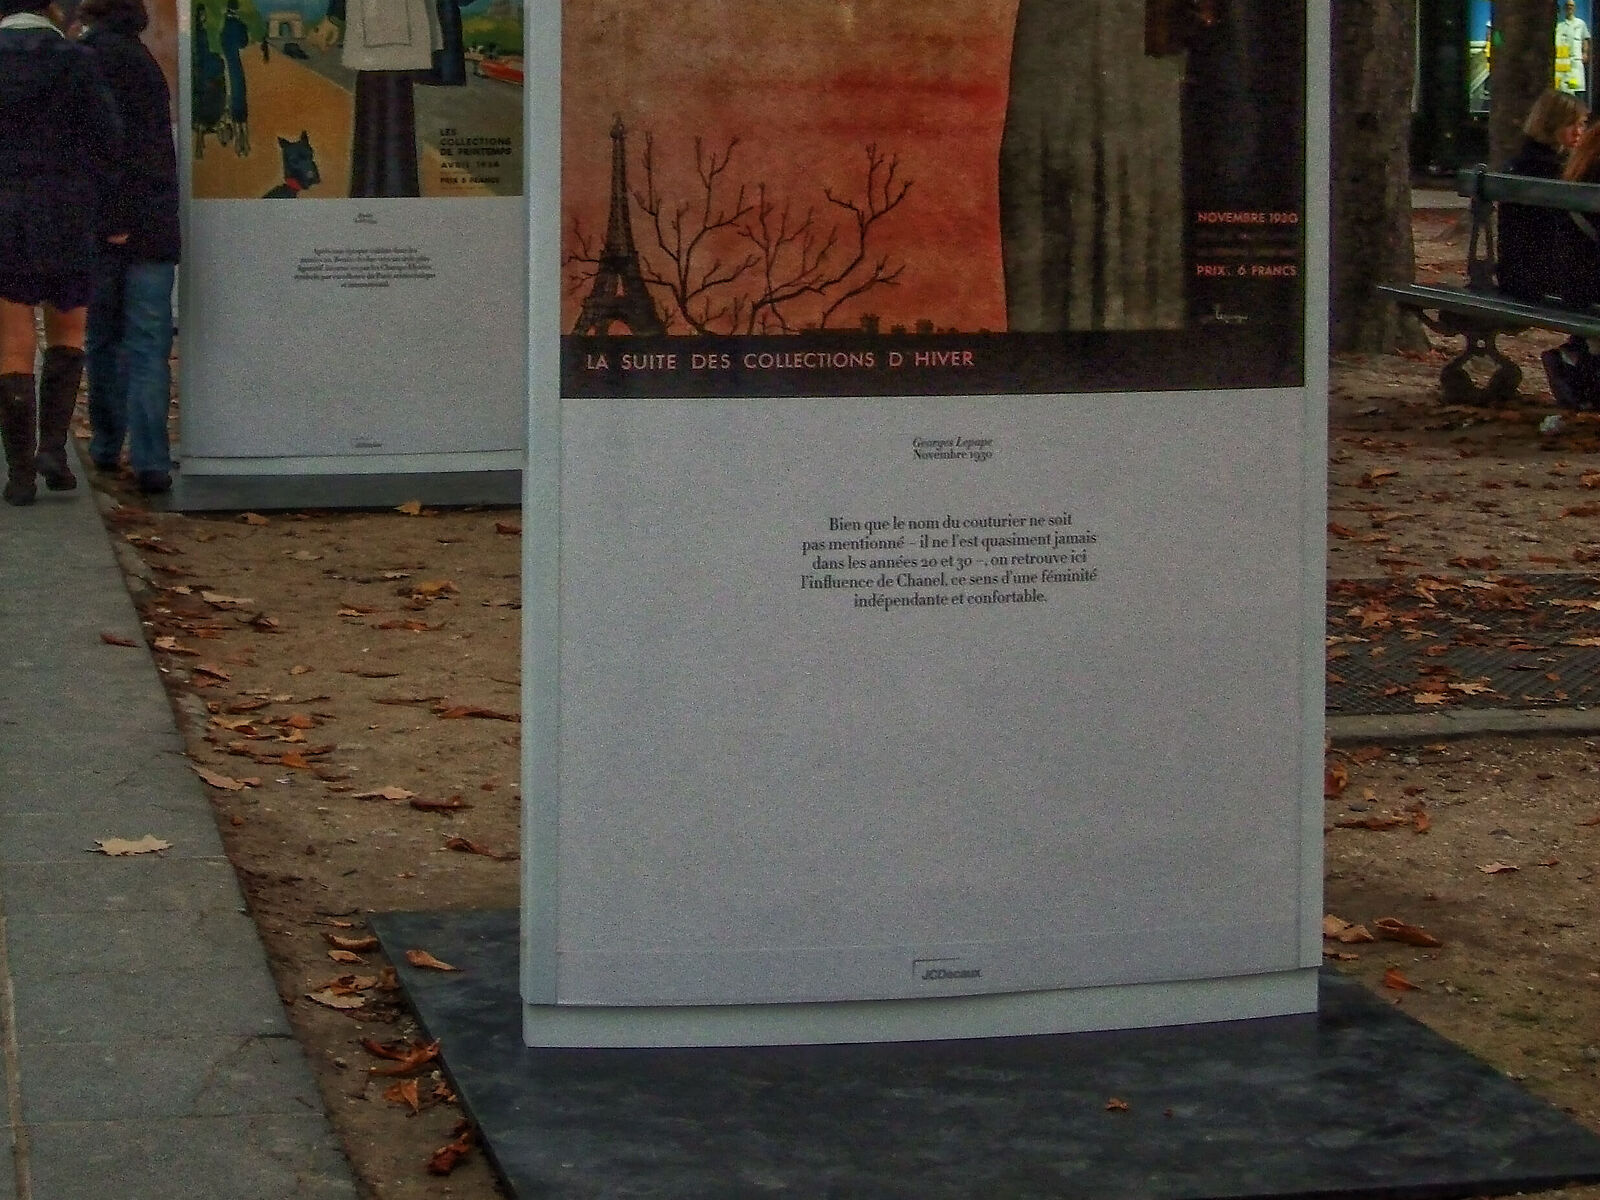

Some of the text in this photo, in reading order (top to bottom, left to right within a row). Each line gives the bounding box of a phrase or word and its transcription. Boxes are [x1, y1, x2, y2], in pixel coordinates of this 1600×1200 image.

[1197, 212, 1299, 223] NOVEMBRE 1930
[1251, 265, 1297, 277] FRANCS
[586, 354, 609, 370] LA
[621, 354, 677, 370] SUITE
[691, 353, 731, 369] DES
[743, 352, 875, 369] COLLECTIONS
[914, 351, 976, 367] HIVER
[912, 448, 967, 460] Novembre
[829, 511, 1073, 535] Bien que le nom du couturier ne soit
[801, 541, 826, 556] pas
[828, 536, 905, 550] mentionné
[919, 535, 929, 549] il
[932, 539, 949, 549] ne
[952, 533, 979, 547] l'est
[981, 532, 1051, 552] quasiment
[1052, 530, 1097, 550] jamais
[812, 556, 844, 569] dans
[848, 555, 867, 569] les
[869, 555, 917, 568] années
[920, 559, 938, 567] 20
[940, 556, 954, 567] et
[956, 557, 973, 571] 30
[990, 556, 1008, 566] on
[1010, 554, 1068, 565] retrouve
[1069, 549, 1087, 564] ici
[801, 574, 873, 589] l'influence
[876, 573, 893, 587] de
[950, 575, 966, 586] ce
[968, 574, 999, 585] sens
[1001, 570, 1038, 584] d'une
[1040, 568, 1098, 583] féminité
[853, 588, 1047, 612] indépendante et confortable.
